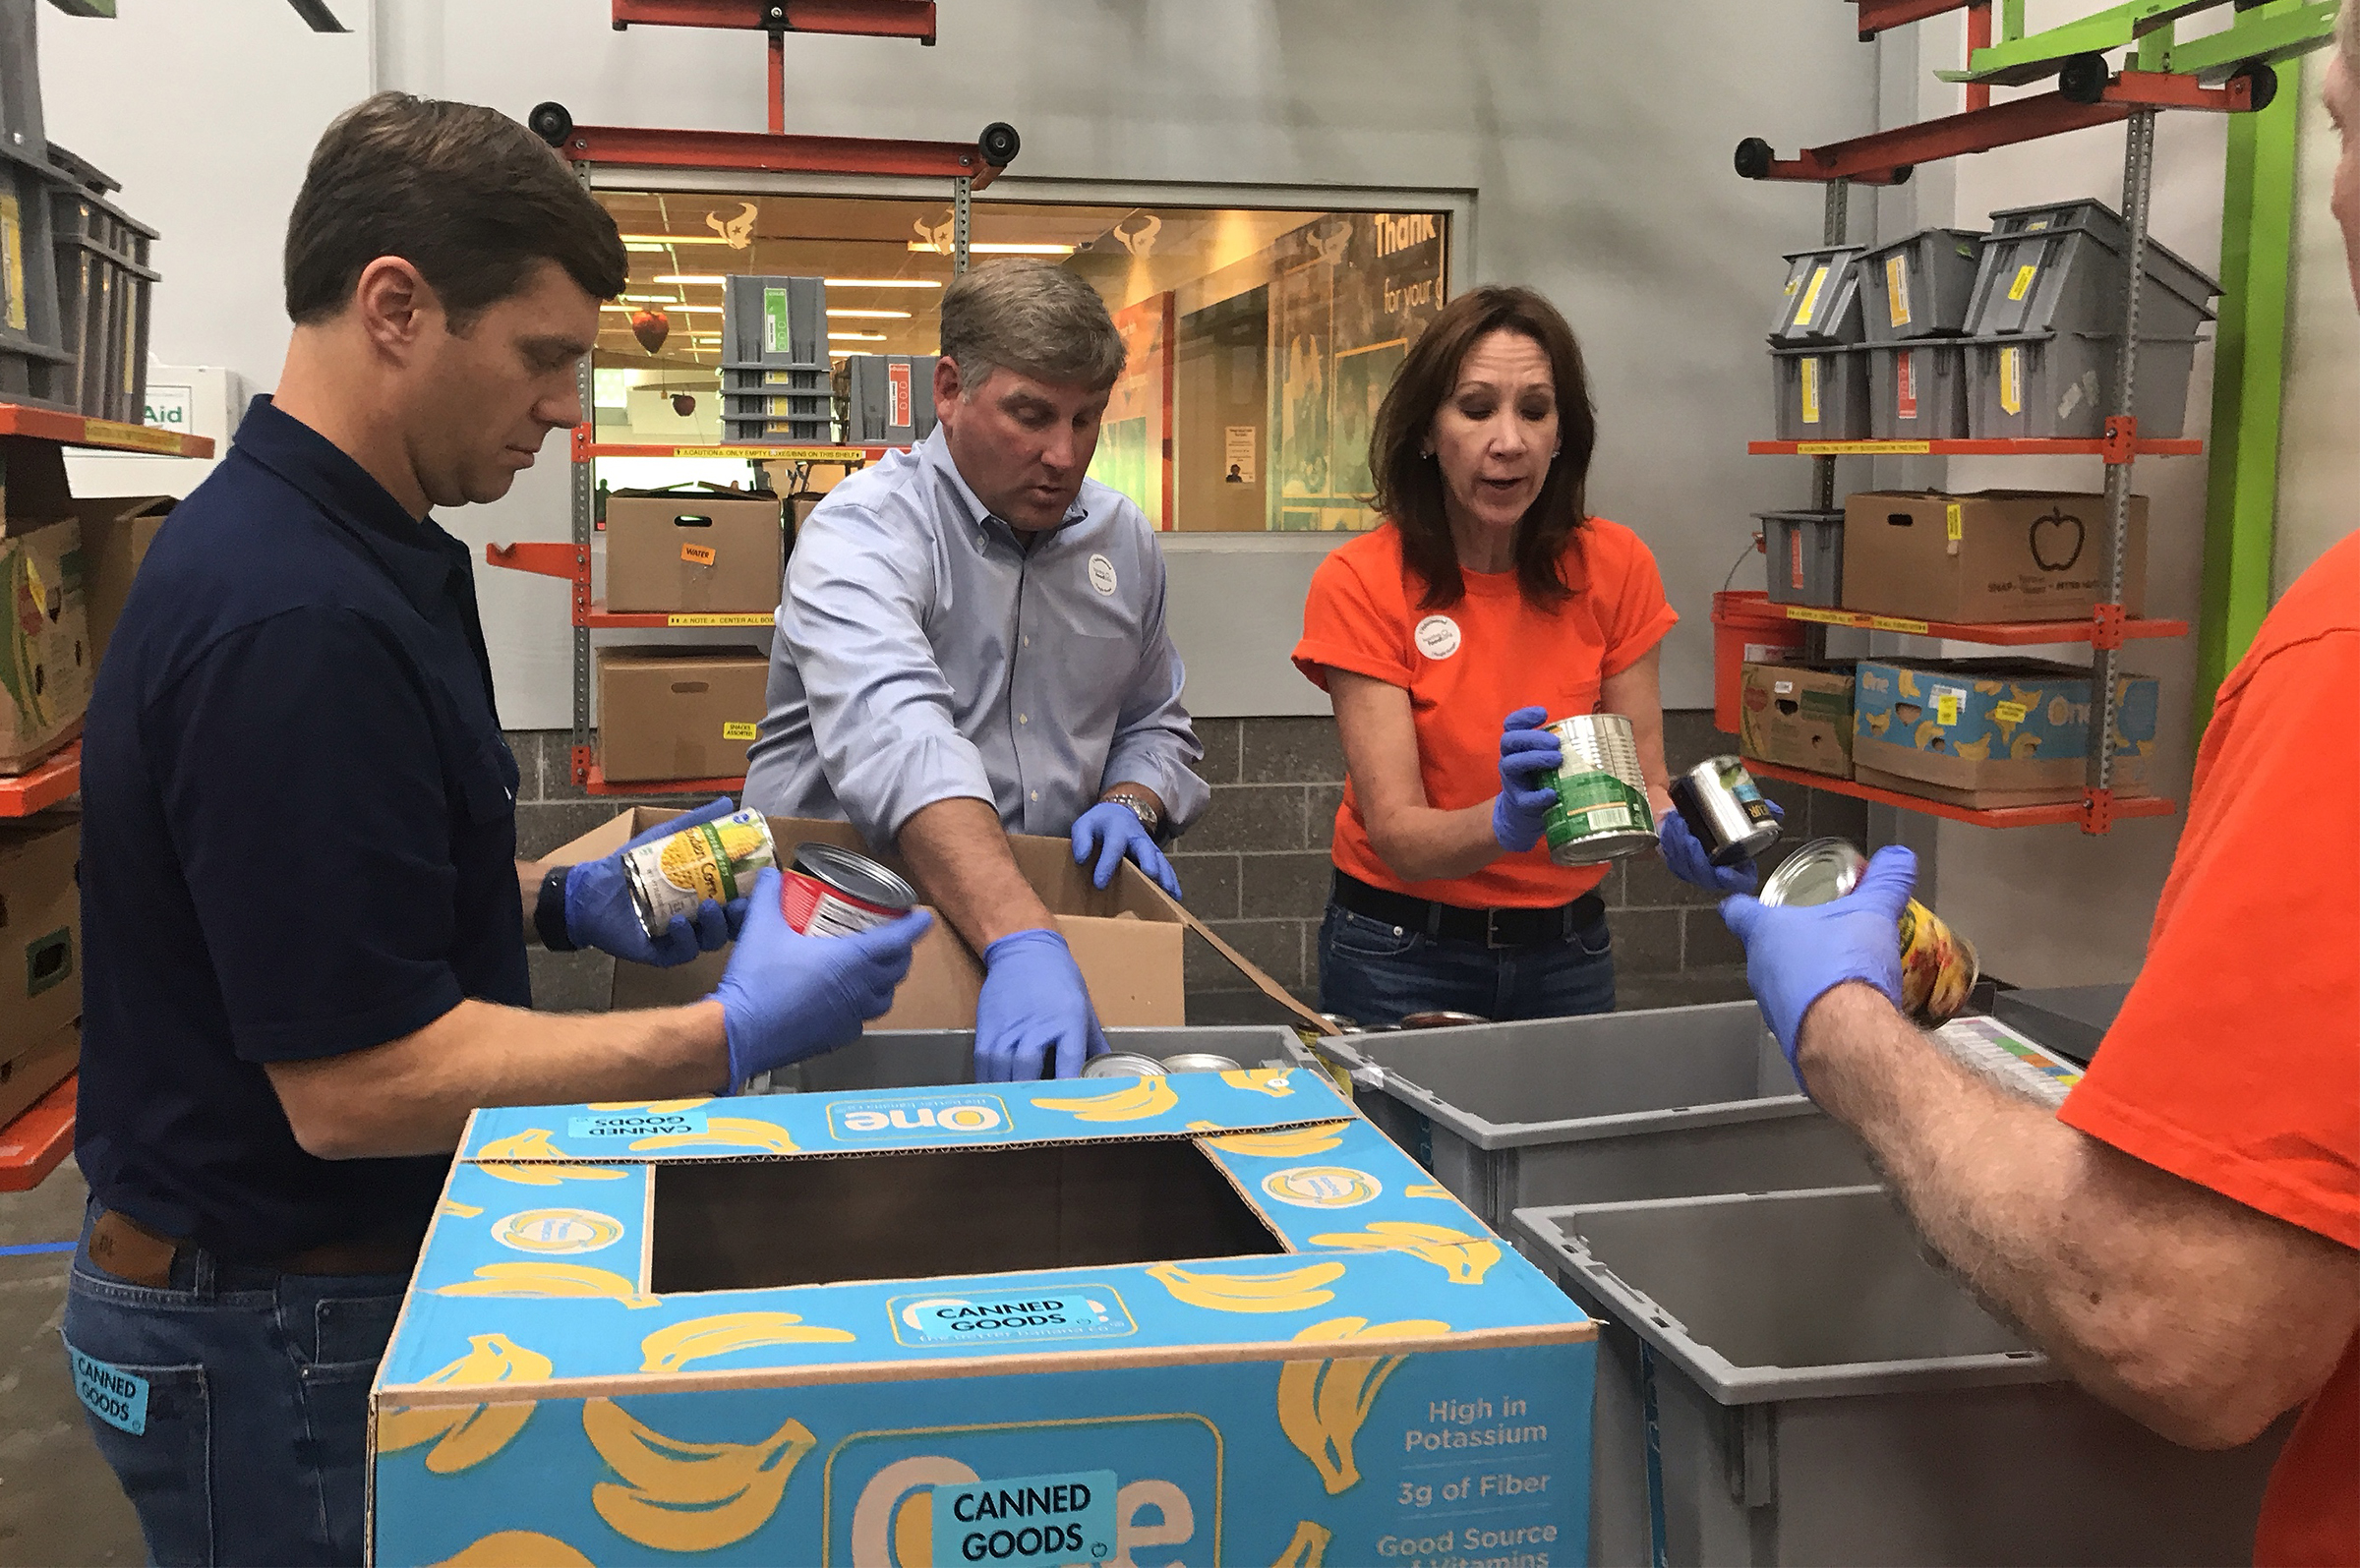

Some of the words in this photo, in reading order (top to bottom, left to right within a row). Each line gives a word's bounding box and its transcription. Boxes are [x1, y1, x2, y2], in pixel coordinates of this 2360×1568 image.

[1374, 213, 1436, 258] Thank
[1384, 277, 1401, 314] for
[1403, 279, 1433, 319] your
[144, 405, 182, 423] Aid
[686, 548, 709, 559] WATER
[701, 862, 718, 899] Corn
[589, 1126, 692, 1135] CANNED
[595, 1116, 685, 1127] GOODS
[844, 1106, 1001, 1131] One
[936, 1300, 1064, 1319] CANNED
[951, 1313, 1067, 1332] GOODS
[79, 1358, 136, 1399] CANNED
[82, 1382, 130, 1422] GOODS
[1429, 1397, 1493, 1424] High
[1503, 1395, 1526, 1417] in
[1405, 1423, 1548, 1452] Potassium
[953, 1482, 1092, 1523] CANNED
[1397, 1481, 1433, 1507] 3g
[1442, 1477, 1471, 1501] of
[1480, 1475, 1551, 1497] Fiber
[962, 1522, 1085, 1561] GOODS
[1377, 1530, 1454, 1556] Good
[1463, 1525, 1558, 1550] Source
